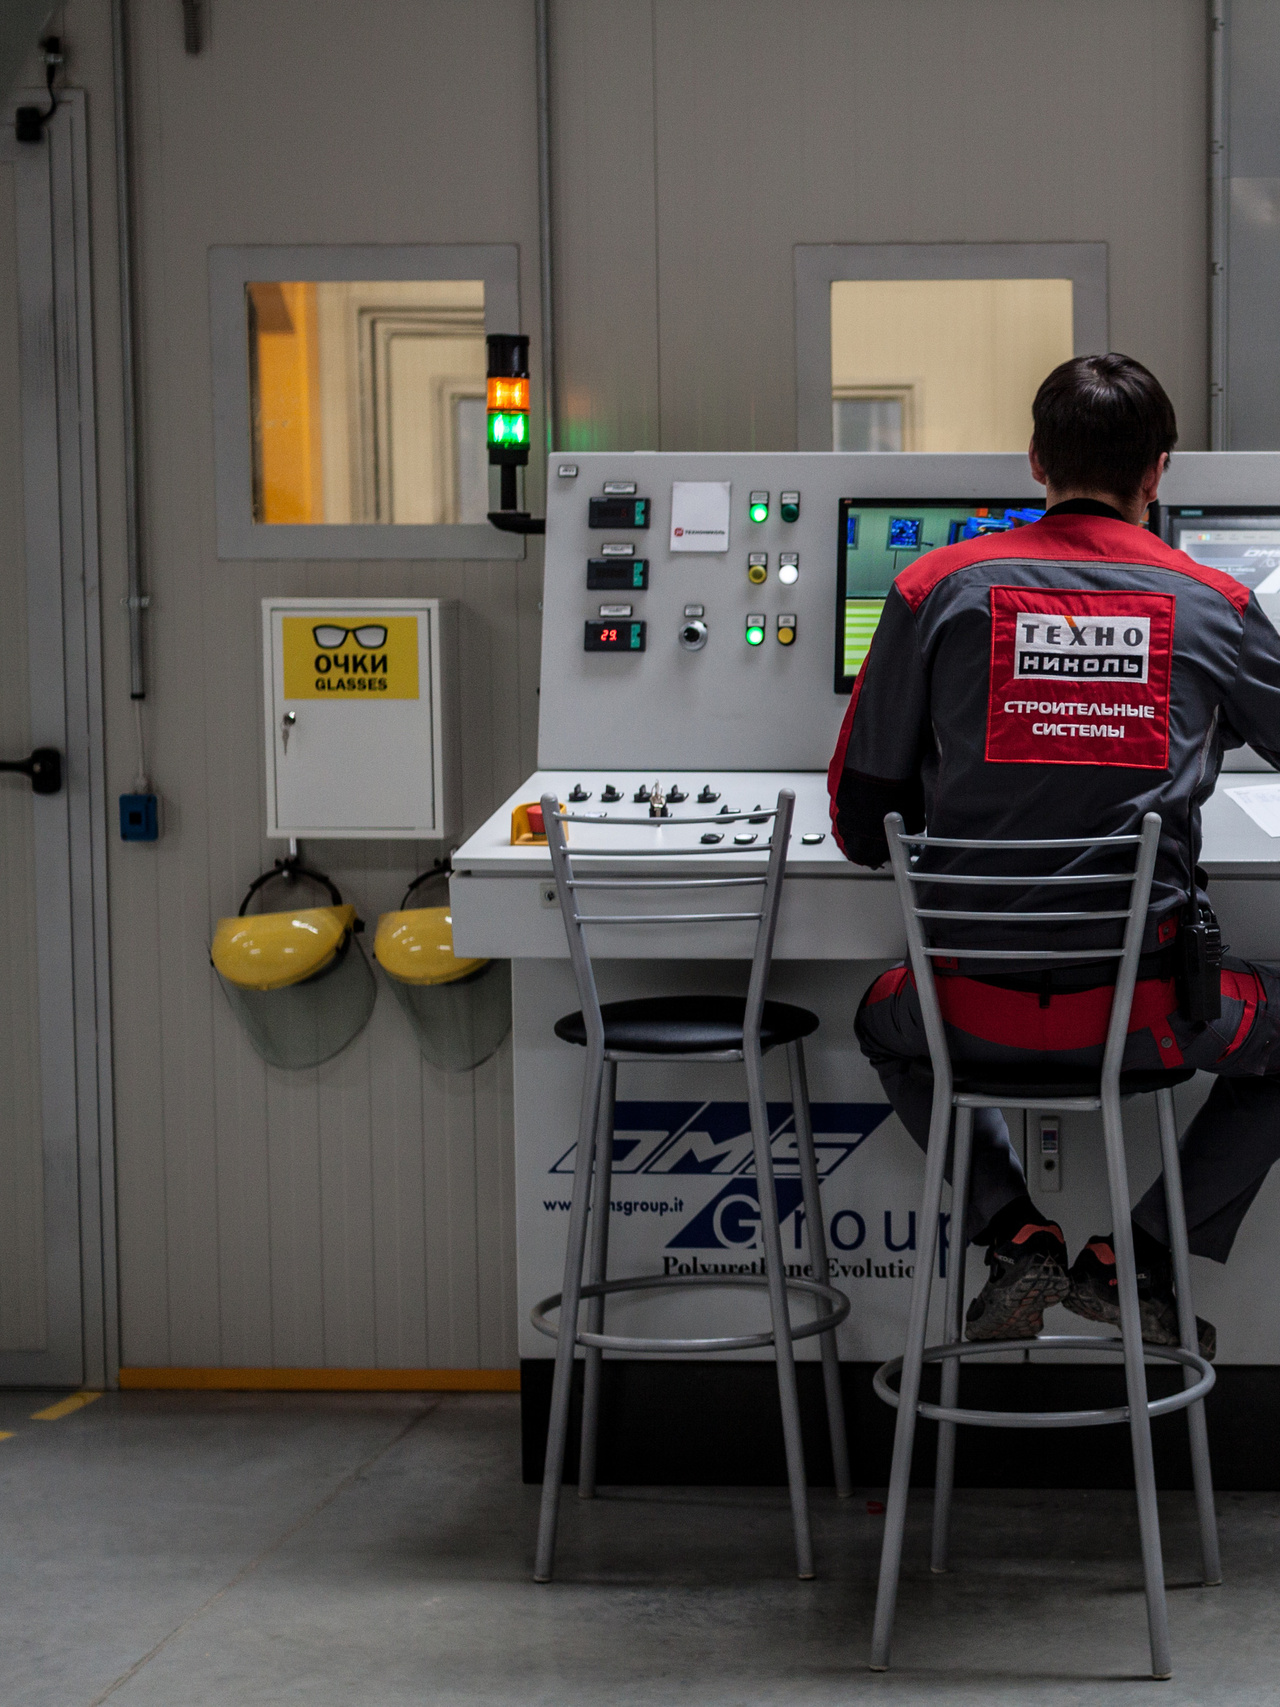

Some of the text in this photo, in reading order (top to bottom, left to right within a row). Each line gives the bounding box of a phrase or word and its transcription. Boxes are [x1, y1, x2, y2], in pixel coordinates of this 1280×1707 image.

[1022, 617, 1143, 647] ТЕХНО
[314, 653, 388, 674] ОЧКИ
[1022, 656, 1139, 673] НИКОЛЬ
[315, 677, 388, 691] GLASSES
[1003, 700, 1155, 719] СТРОИТЕЛЬНЫЕ
[1032, 722, 1125, 739] СИСТЕМЫ
[543, 1196, 684, 1216] ww.sgroup.it
[662, 1256, 915, 1279] Polyuretne Evolutio
